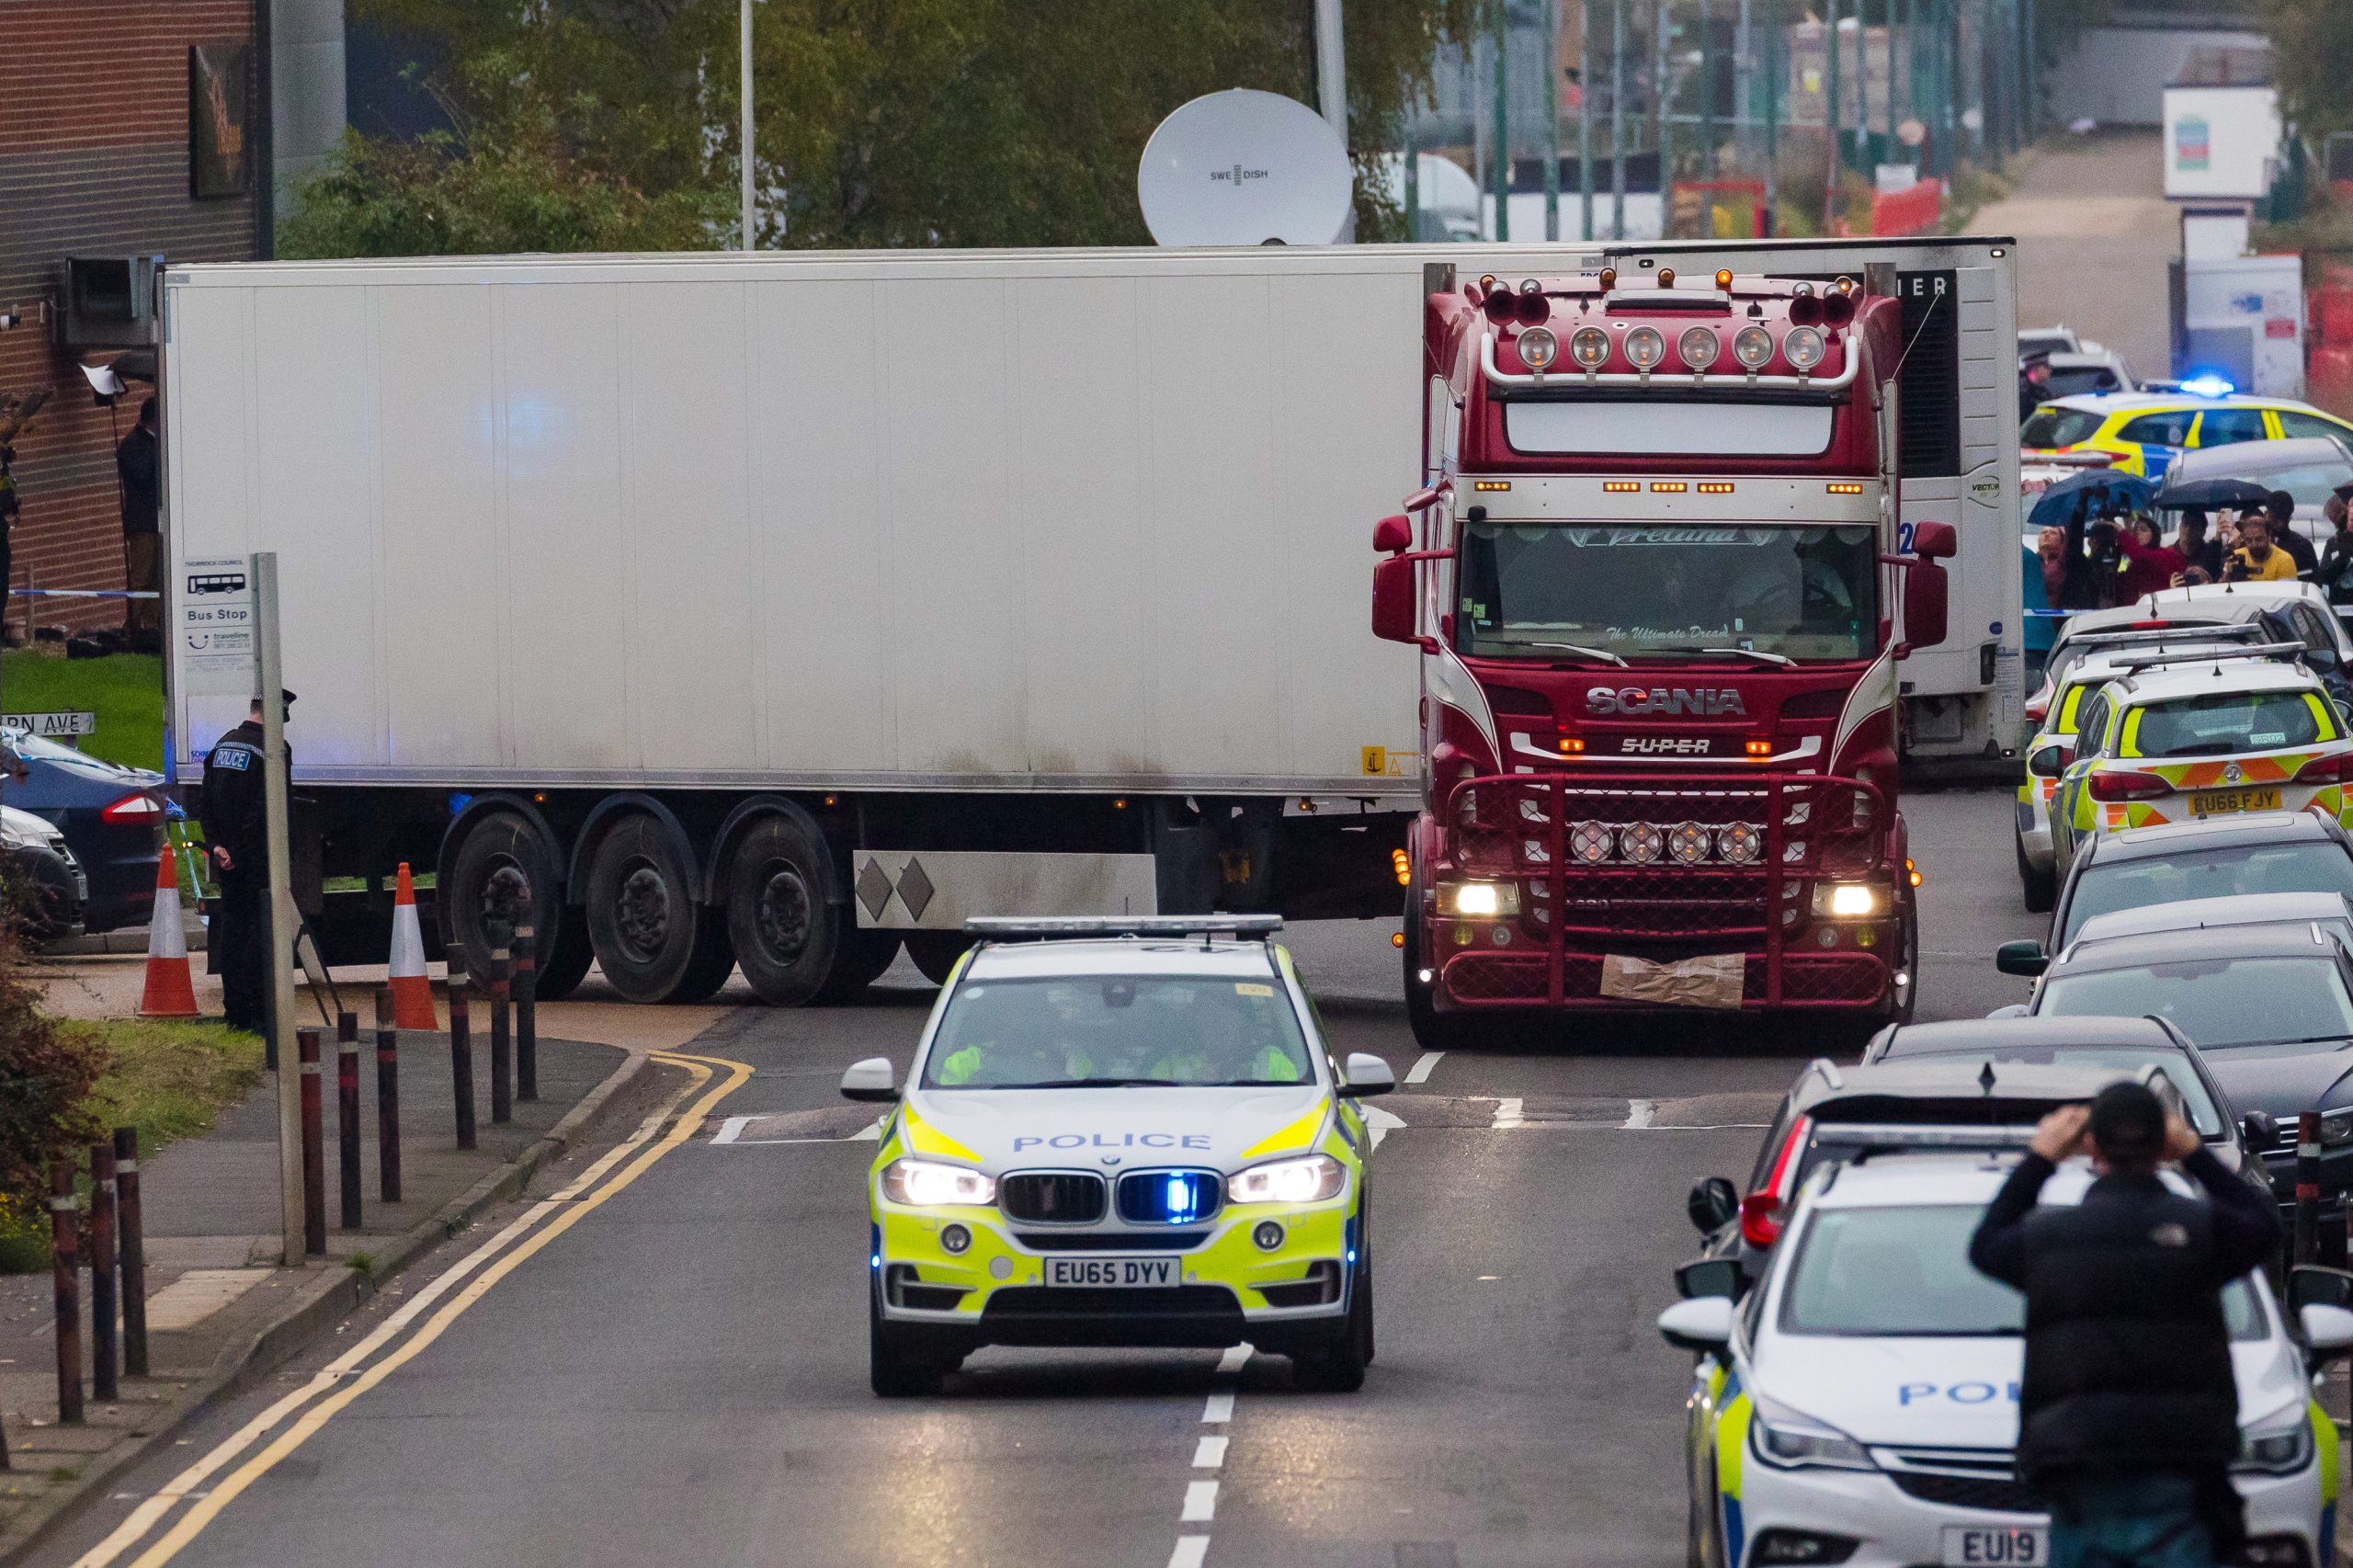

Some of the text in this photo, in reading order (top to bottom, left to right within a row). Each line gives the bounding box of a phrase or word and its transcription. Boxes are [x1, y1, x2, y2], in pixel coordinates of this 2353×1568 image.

[1210, 170, 1268, 180] SWE DISH
[1972, 483, 2000, 492] VECTOR
[188, 608, 247, 621] Bus Stop
[1606, 624, 1729, 642] The Ultimate Dream
[1586, 687, 1747, 715] SCANIA
[44, 714, 80, 733] AVE
[1620, 738, 1710, 754] SUPER
[216, 750, 246, 767] POLICE
[2194, 791, 2274, 813] EU66 FJY
[1013, 1133, 1211, 1153] POLICE
[1055, 1262, 1170, 1284] EU65 DYV
[1962, 1530, 2036, 1562] EU19
